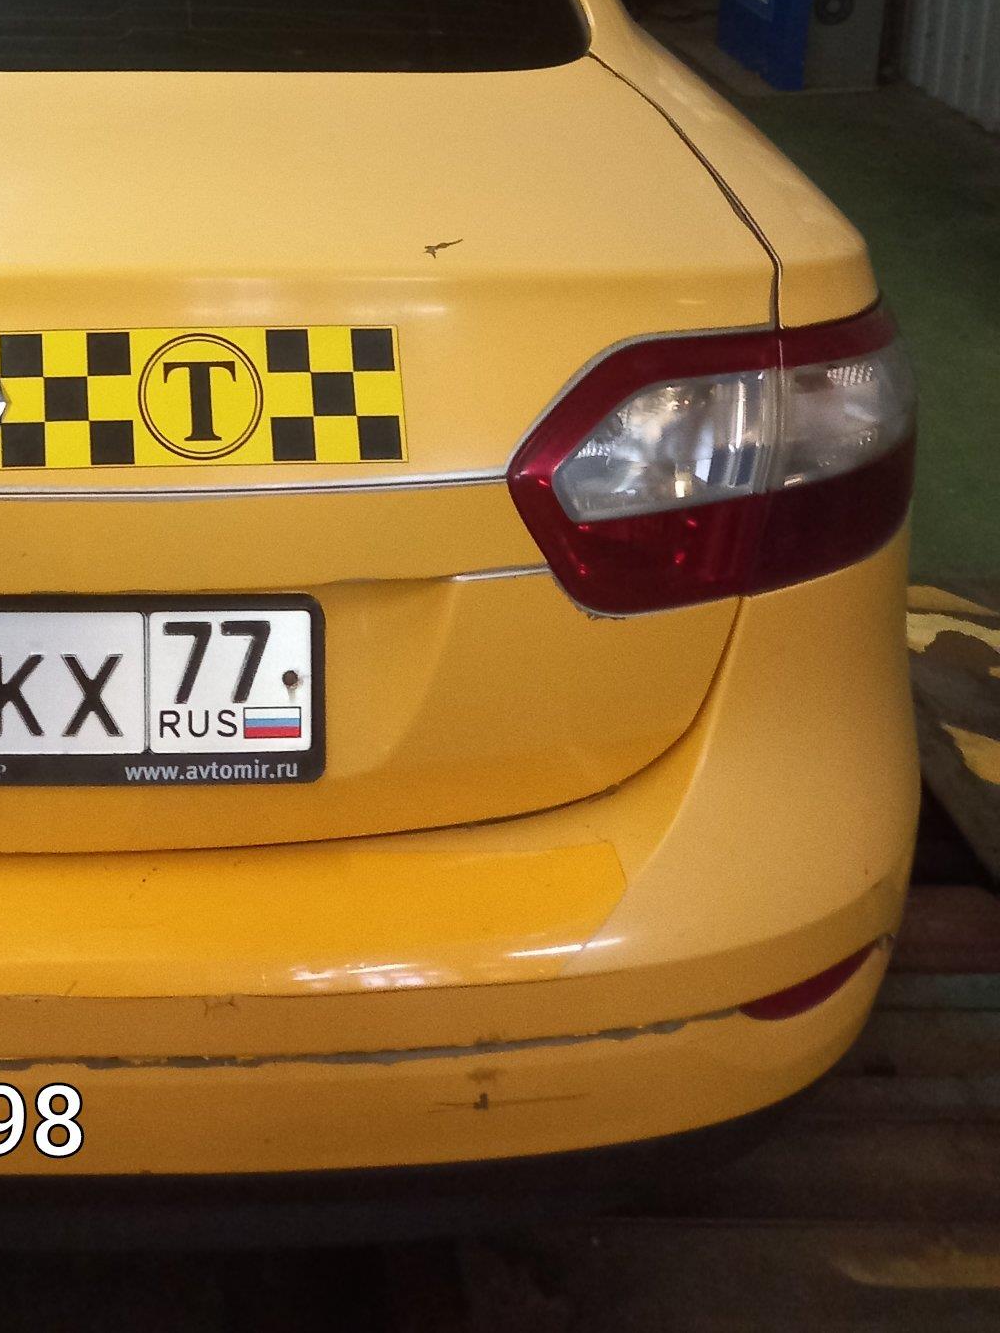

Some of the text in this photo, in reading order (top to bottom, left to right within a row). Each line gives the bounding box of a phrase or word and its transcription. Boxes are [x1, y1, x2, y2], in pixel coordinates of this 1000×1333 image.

[162, 620, 272, 705] 77
[159, 710, 238, 739] RUS
[124, 758, 299, 781] www.avtomir.ru
